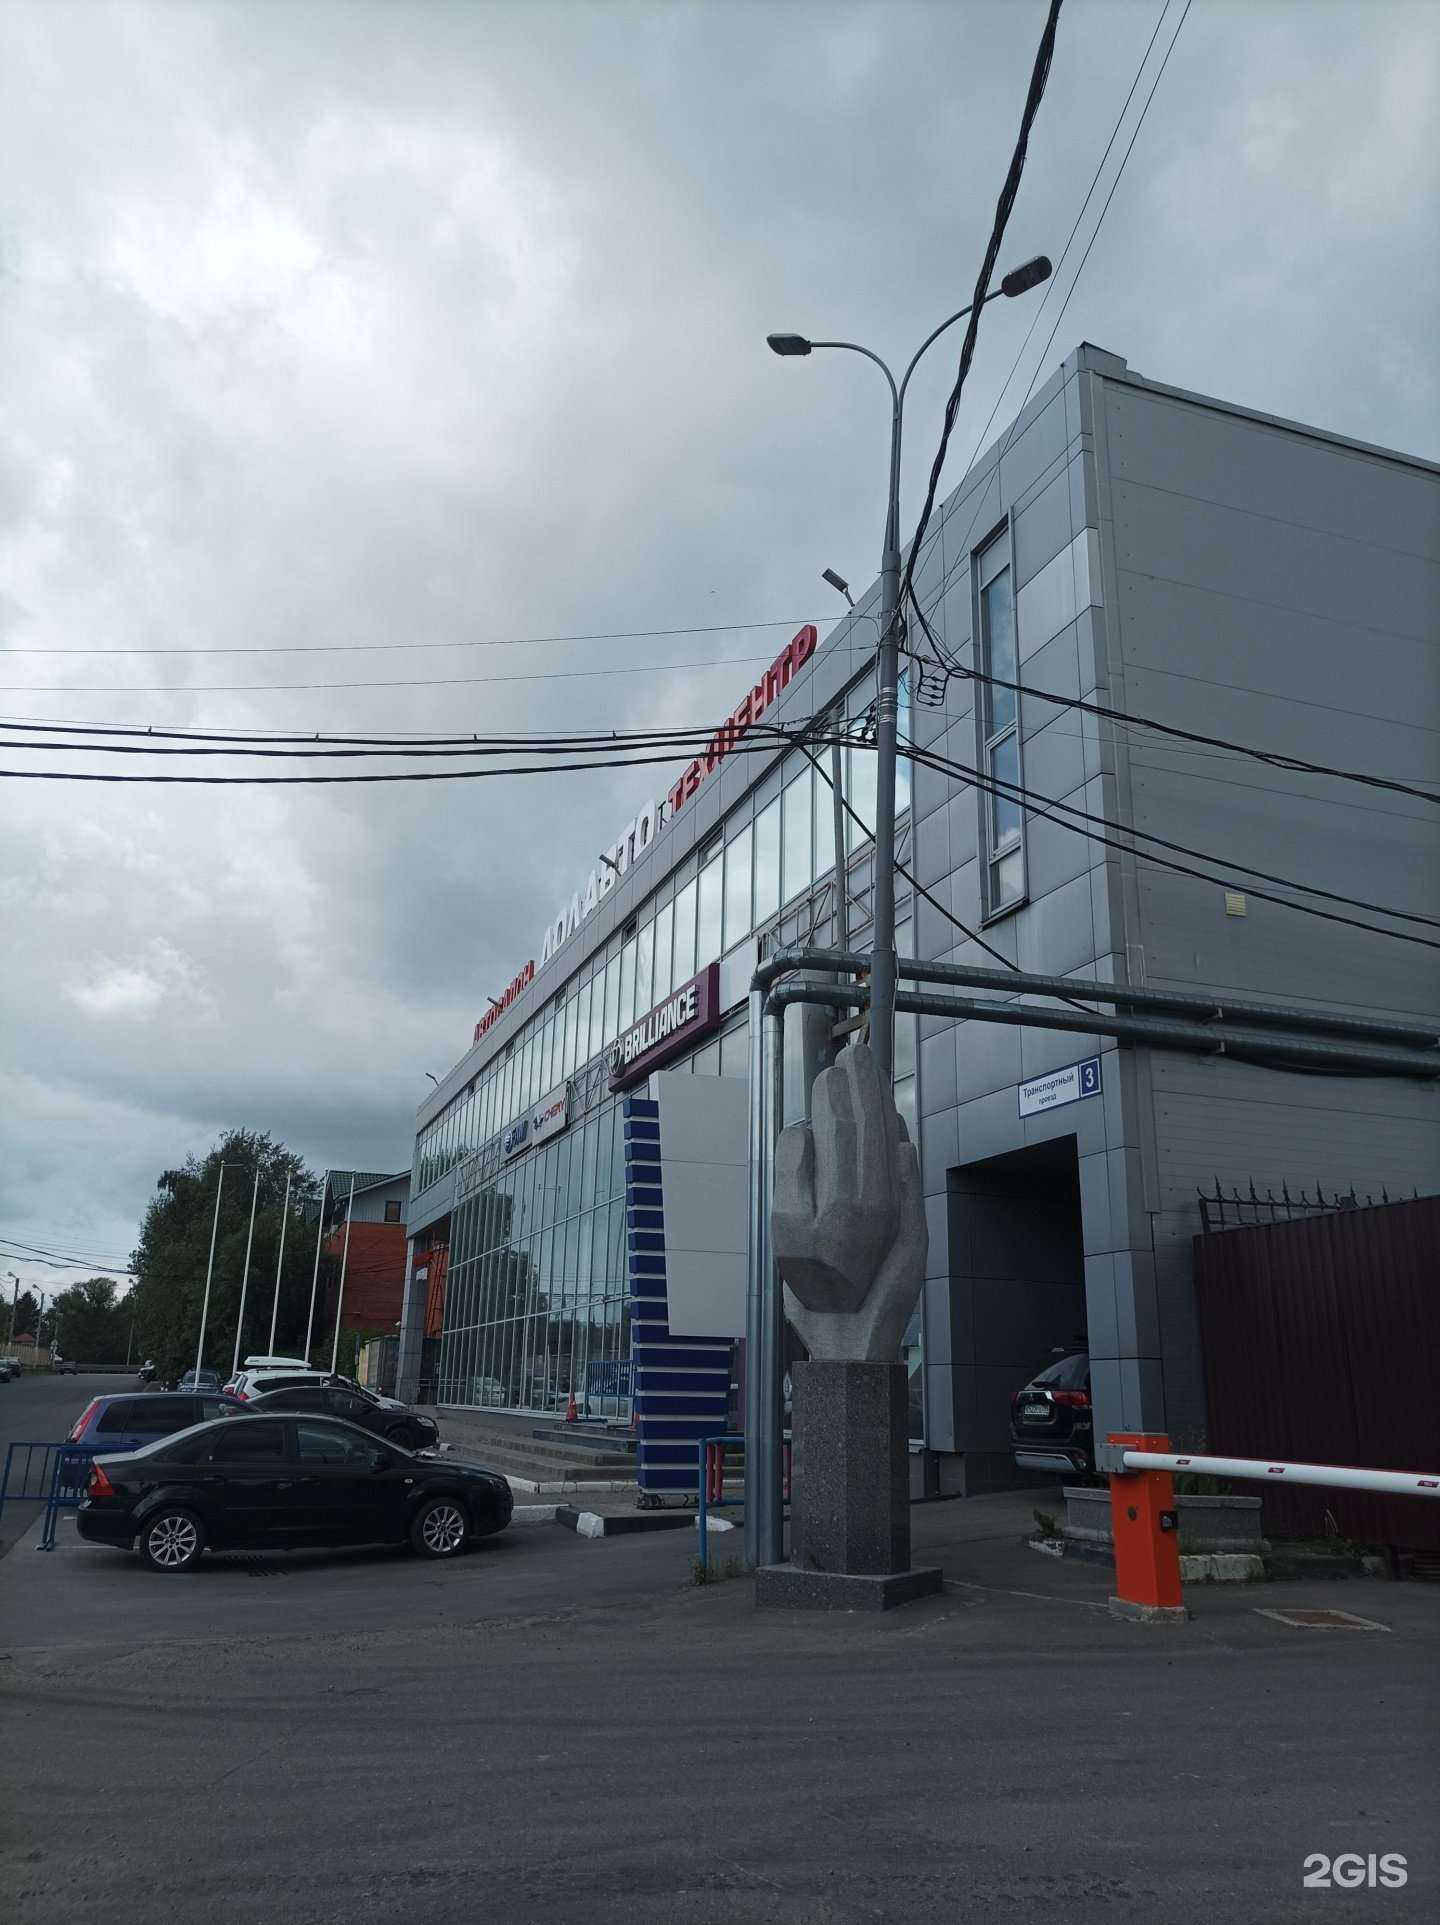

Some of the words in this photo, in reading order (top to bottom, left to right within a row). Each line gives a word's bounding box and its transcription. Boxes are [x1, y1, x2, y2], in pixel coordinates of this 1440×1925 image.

[624, 984, 697, 1065] BRILLIANCE
[1023, 1072, 1074, 1099] Транспортный
[1085, 1068, 1095, 1088] 3
